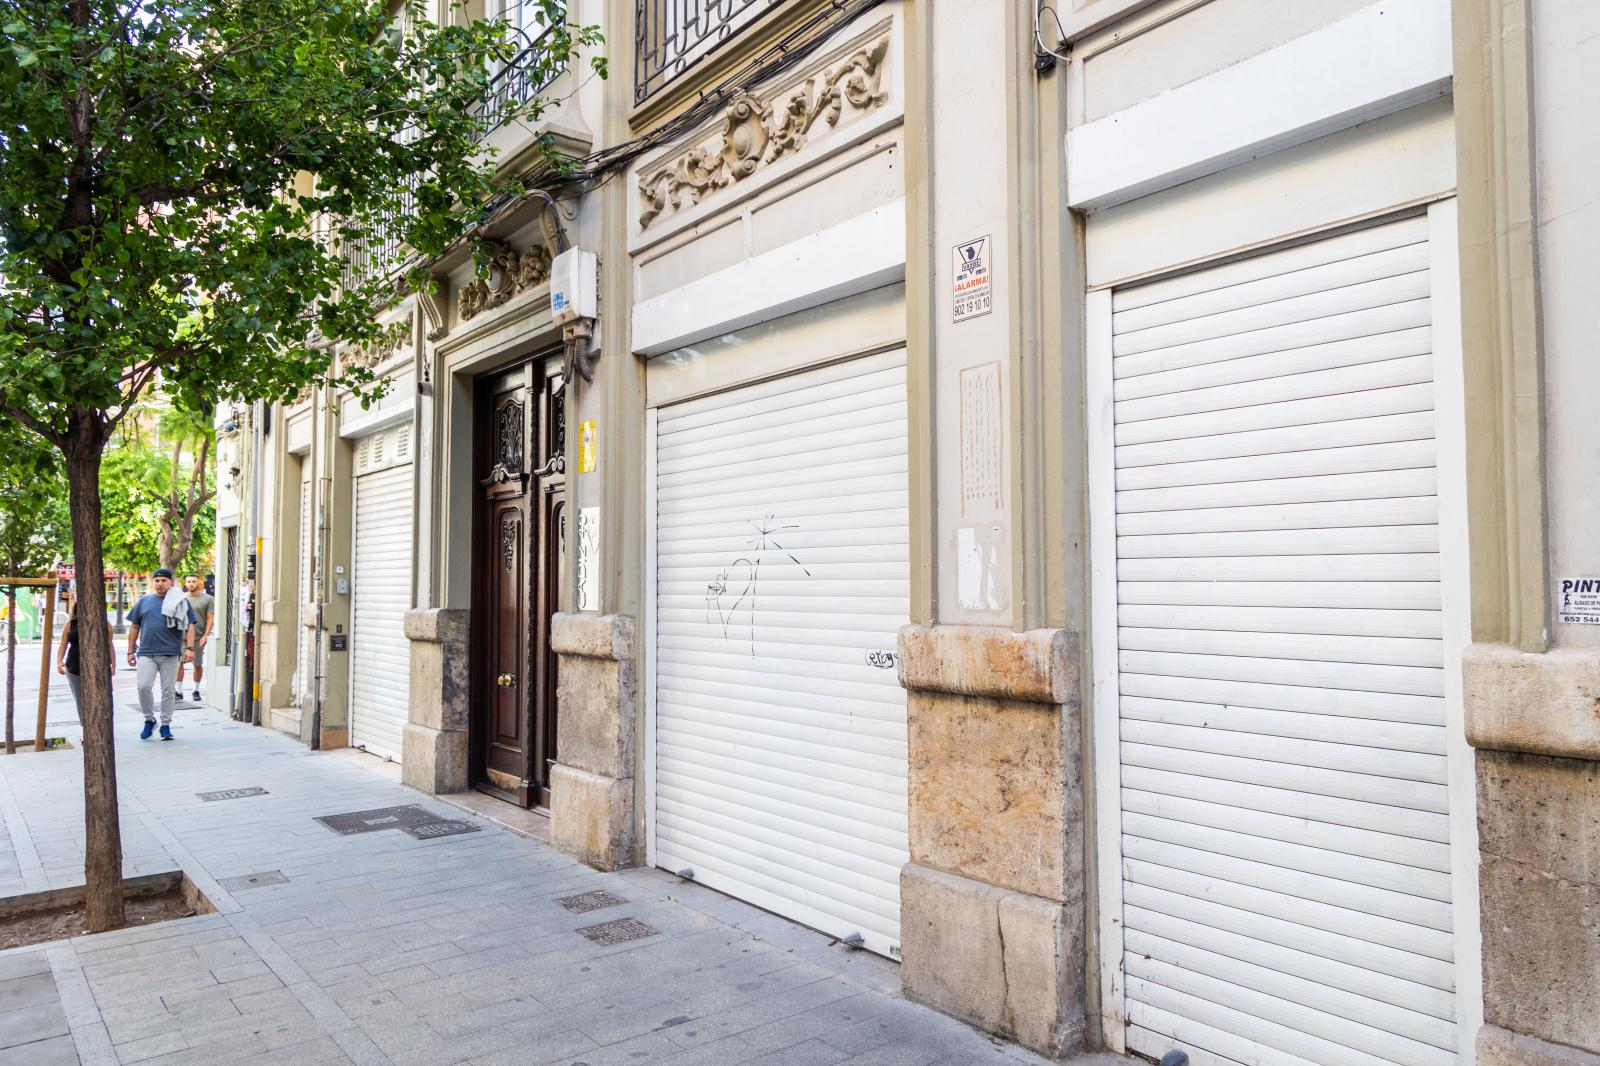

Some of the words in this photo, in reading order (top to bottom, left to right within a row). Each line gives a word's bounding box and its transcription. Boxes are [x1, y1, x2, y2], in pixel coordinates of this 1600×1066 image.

[955, 304, 965, 316] 902
[967, 301, 974, 312] 19
[975, 299, 981, 310] 10
[983, 296, 990, 307] 10
